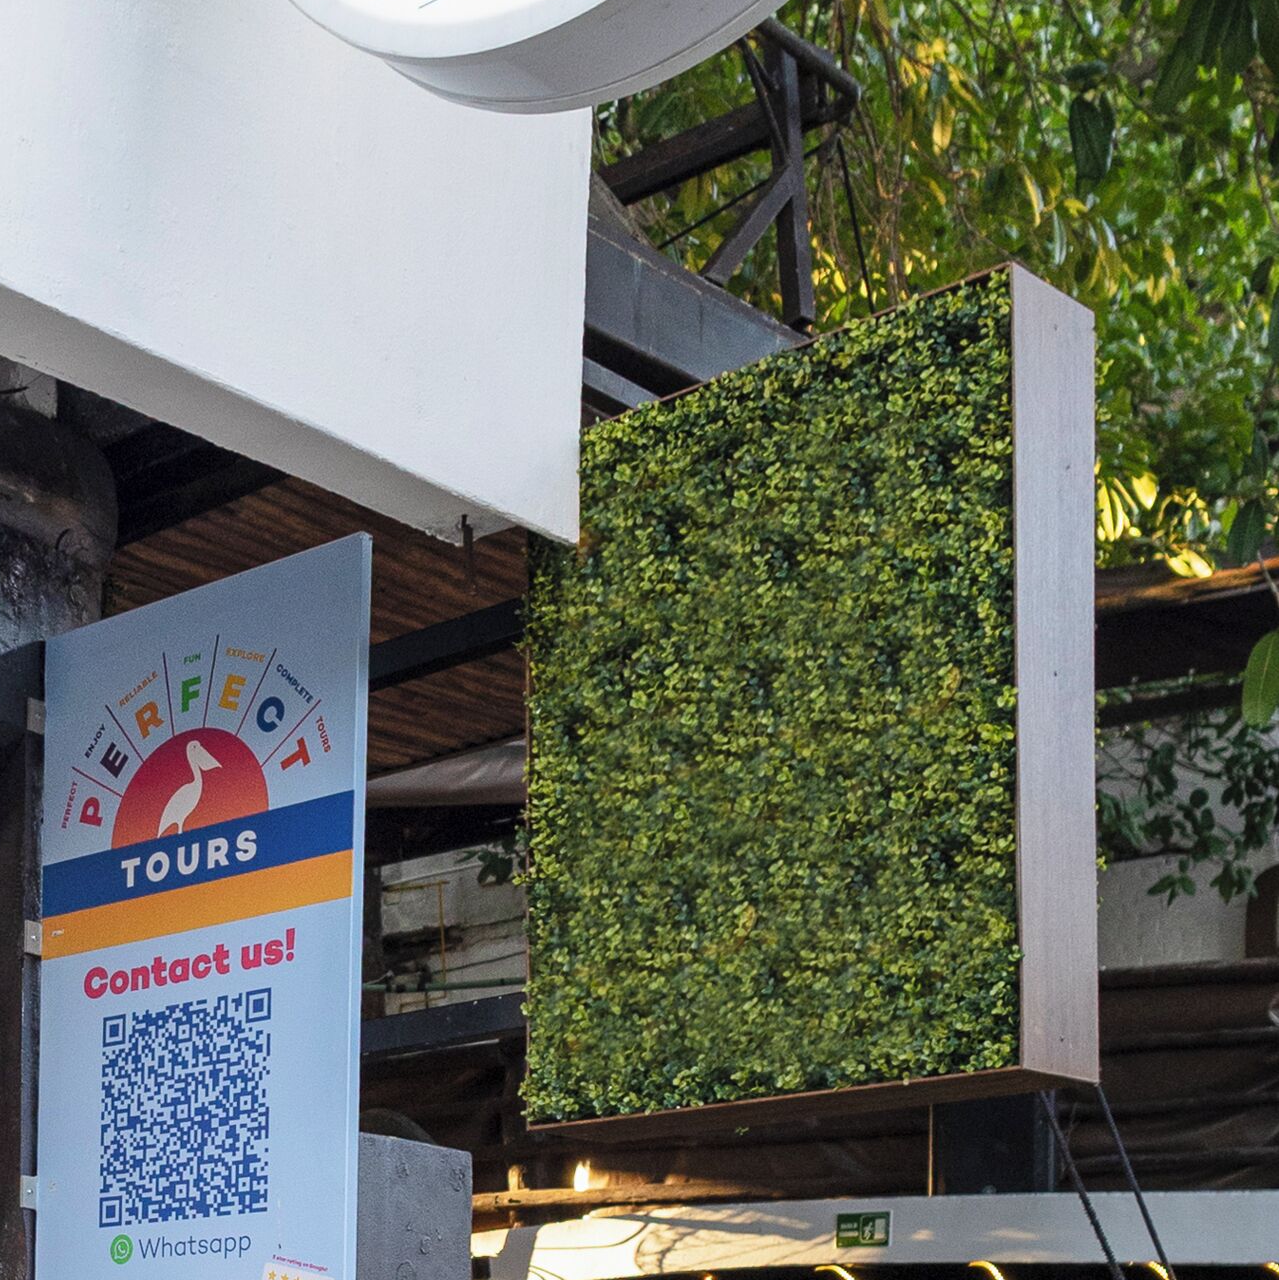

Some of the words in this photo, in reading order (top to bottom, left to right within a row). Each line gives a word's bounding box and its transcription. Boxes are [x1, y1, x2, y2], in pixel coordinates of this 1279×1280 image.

[183, 653, 202, 665] FUN
[226, 647, 266, 663] EXPLORE
[119, 671, 158, 707] RELIABLE
[276, 663, 314, 704] COMPLETE
[80, 673, 311, 827] PERFECT
[84, 723, 106, 759] ENJOY
[315, 716, 331, 753] TOURS
[61, 780, 78, 829] PERFECT
[120, 830, 258, 888] TOURS
[83, 943, 231, 1000] Contact
[241, 927, 296, 970] us!
[138, 1234, 252, 1259] Whatsapp
